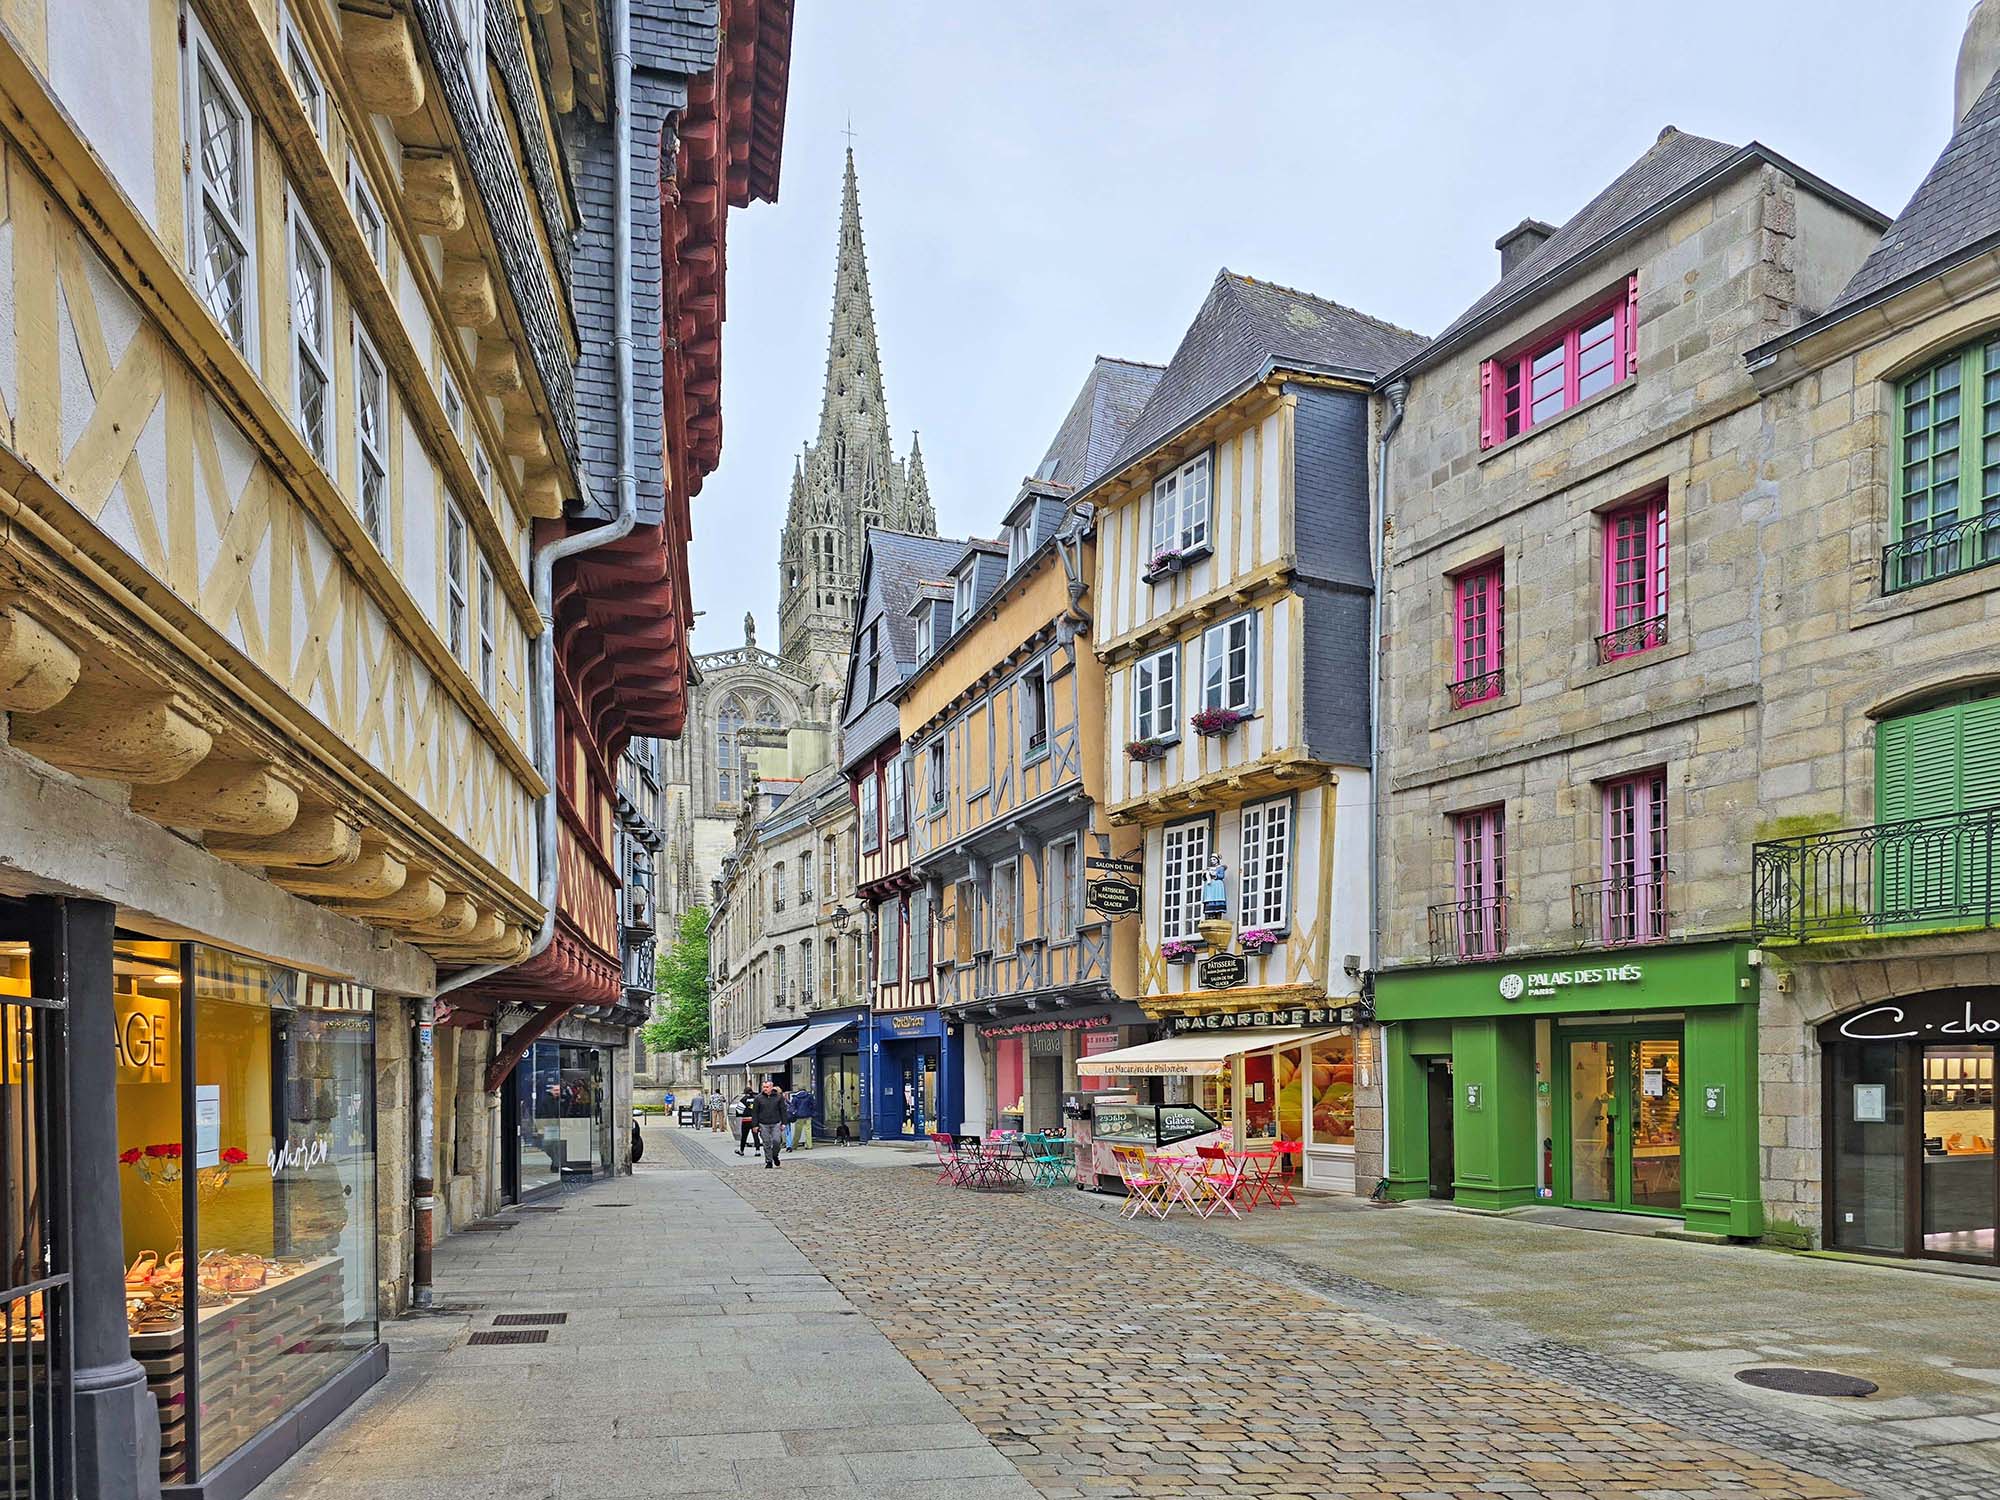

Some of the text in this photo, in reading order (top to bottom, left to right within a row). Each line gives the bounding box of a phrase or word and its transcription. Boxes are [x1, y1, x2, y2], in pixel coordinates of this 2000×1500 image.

[1207, 960, 1236, 969] PÂTISSERIE
[1527, 963, 1643, 987] PALAIS DES THÉS
[1527, 987, 1556, 996] PARIS
[1174, 1007, 1355, 1030] MACARONERIE
[1032, 1034, 1061, 1053] Amaya
[1104, 1065, 1114, 1073] Les
[1145, 1064, 1153, 1073] de
[1154, 1062, 1189, 1073] Philomène
[1165, 1114, 1195, 1125] Glaces
